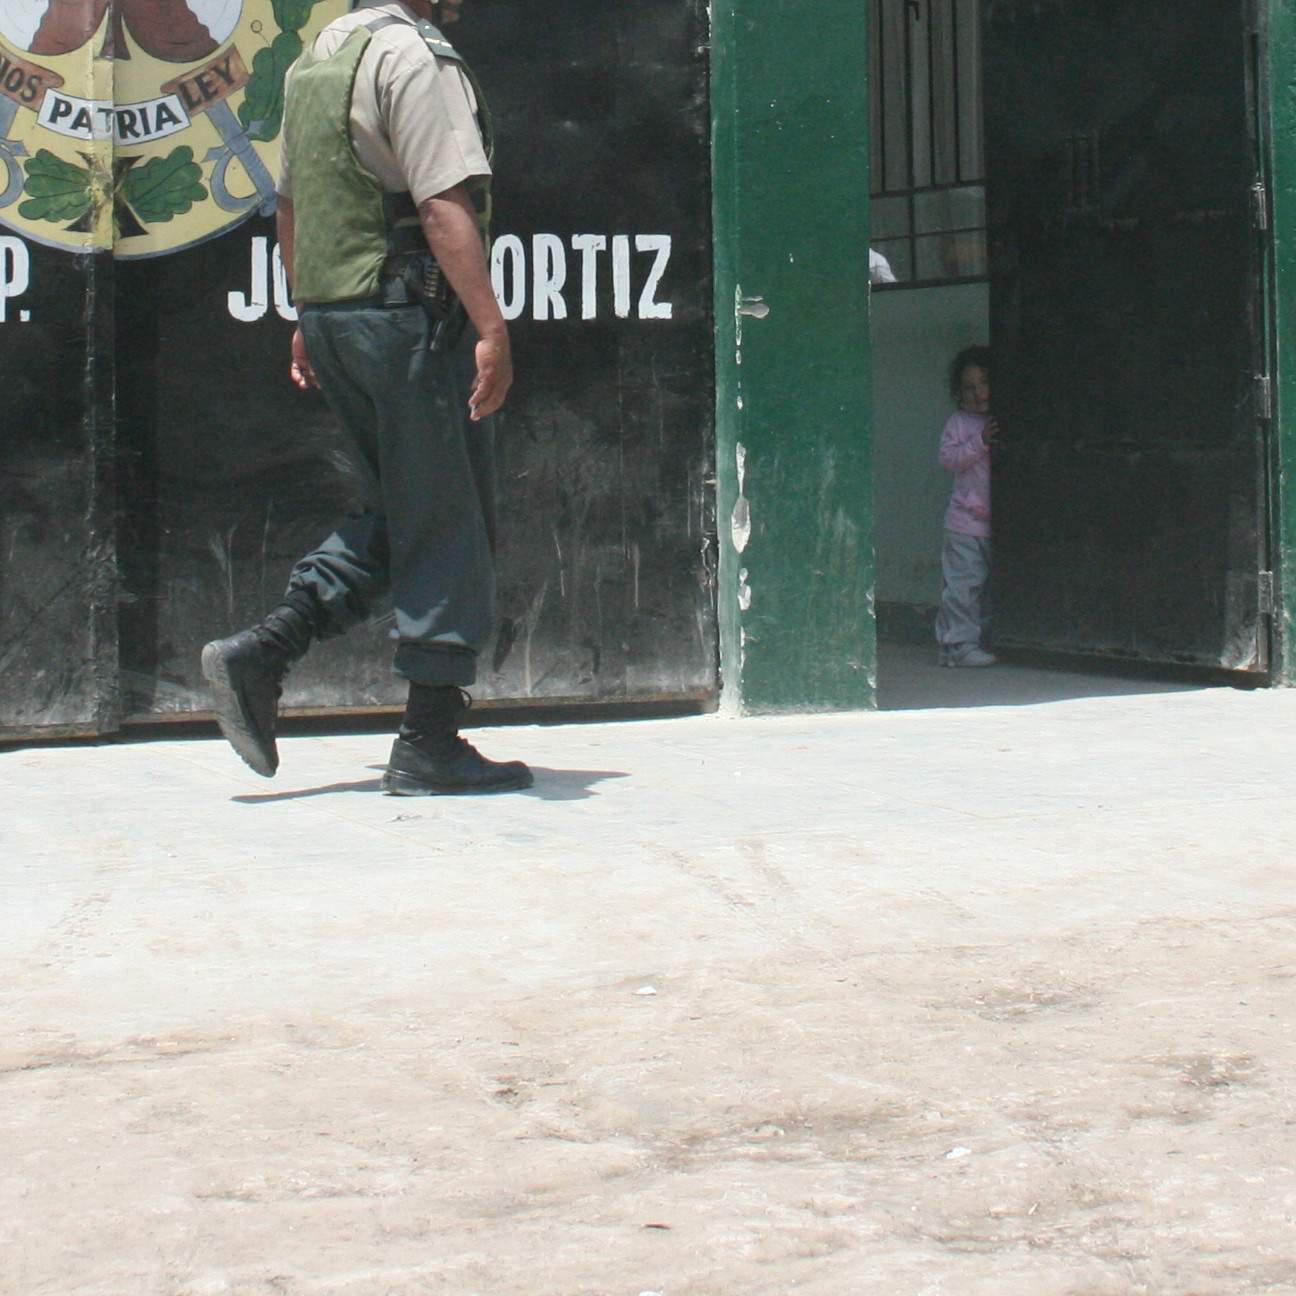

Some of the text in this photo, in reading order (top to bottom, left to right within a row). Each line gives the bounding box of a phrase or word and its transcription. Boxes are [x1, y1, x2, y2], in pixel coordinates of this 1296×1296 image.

[47, 96, 183, 141] PATRIA
[177, 58, 236, 109] LEY
[490, 233, 673, 321] ORTIZ
